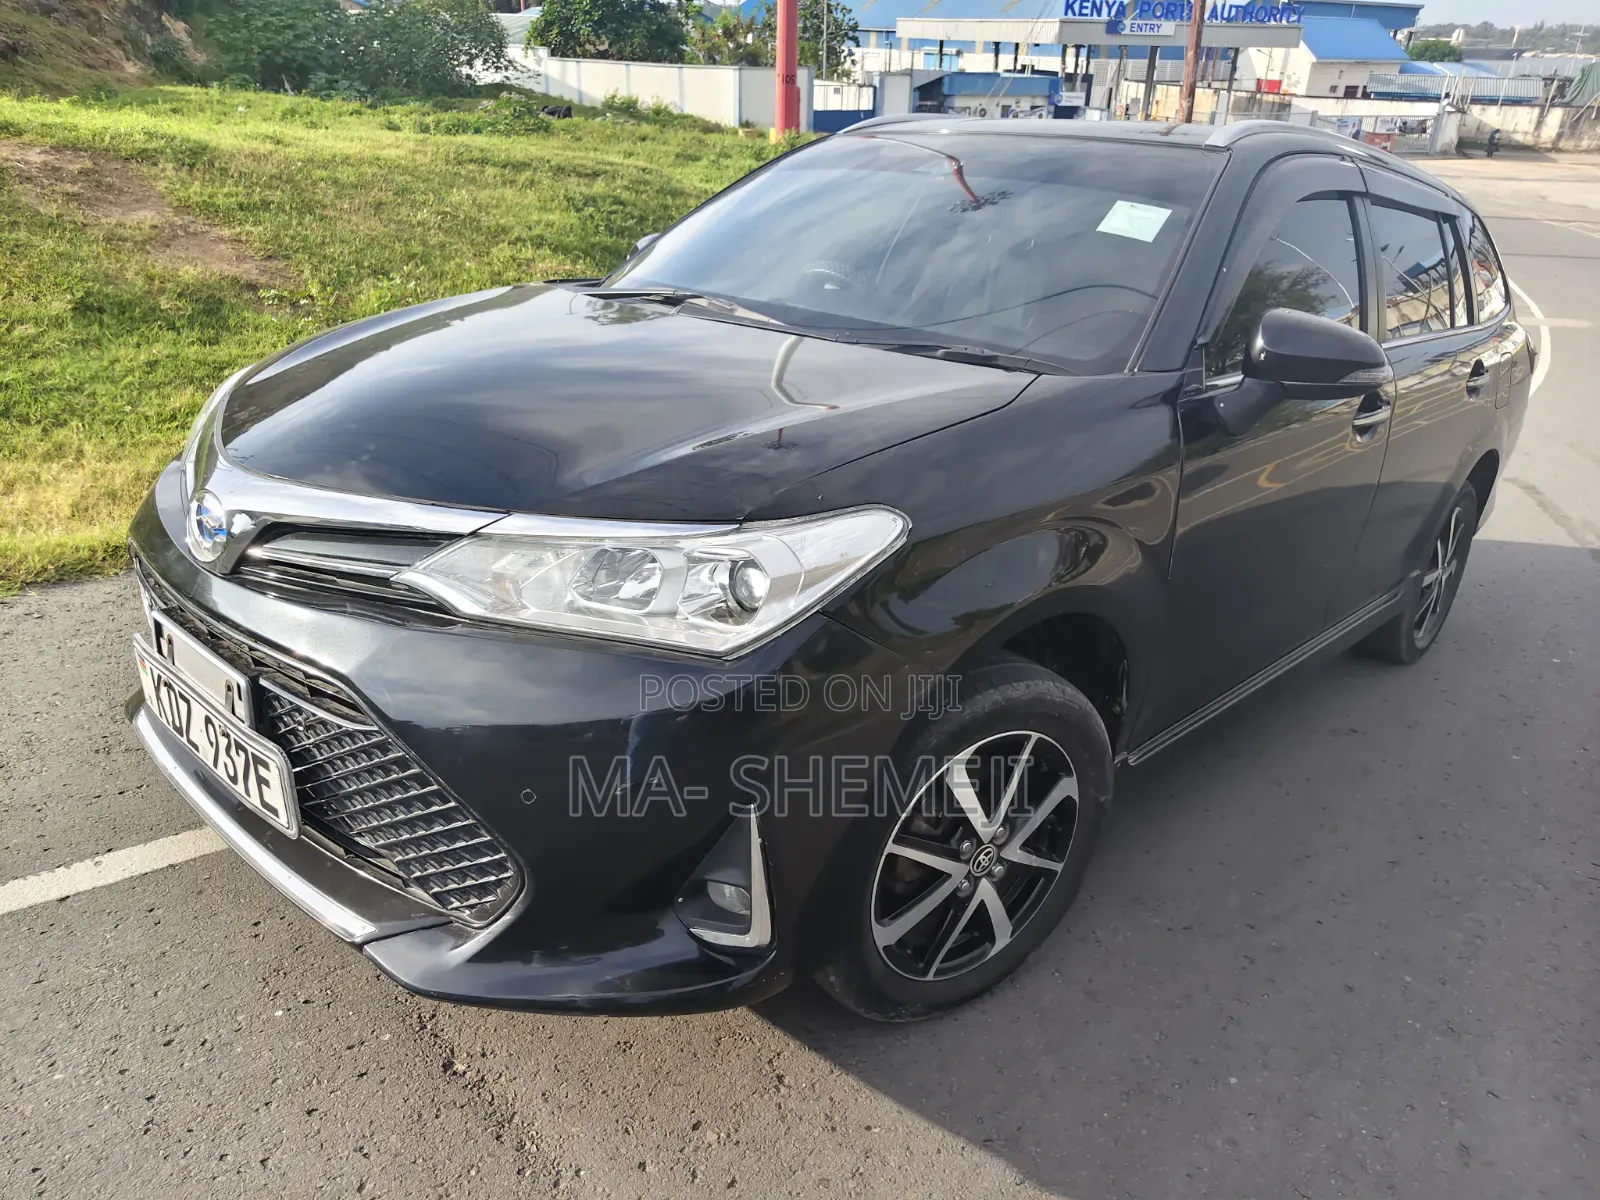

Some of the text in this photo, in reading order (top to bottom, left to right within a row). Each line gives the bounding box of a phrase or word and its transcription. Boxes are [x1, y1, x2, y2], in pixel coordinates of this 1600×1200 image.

[1064, 0, 1127, 17] KENYA
[1206, 3, 1306, 24] AUTHORITY
[1129, 22, 1163, 34] ENTRY
[150, 666, 280, 820] KDZ 937E
